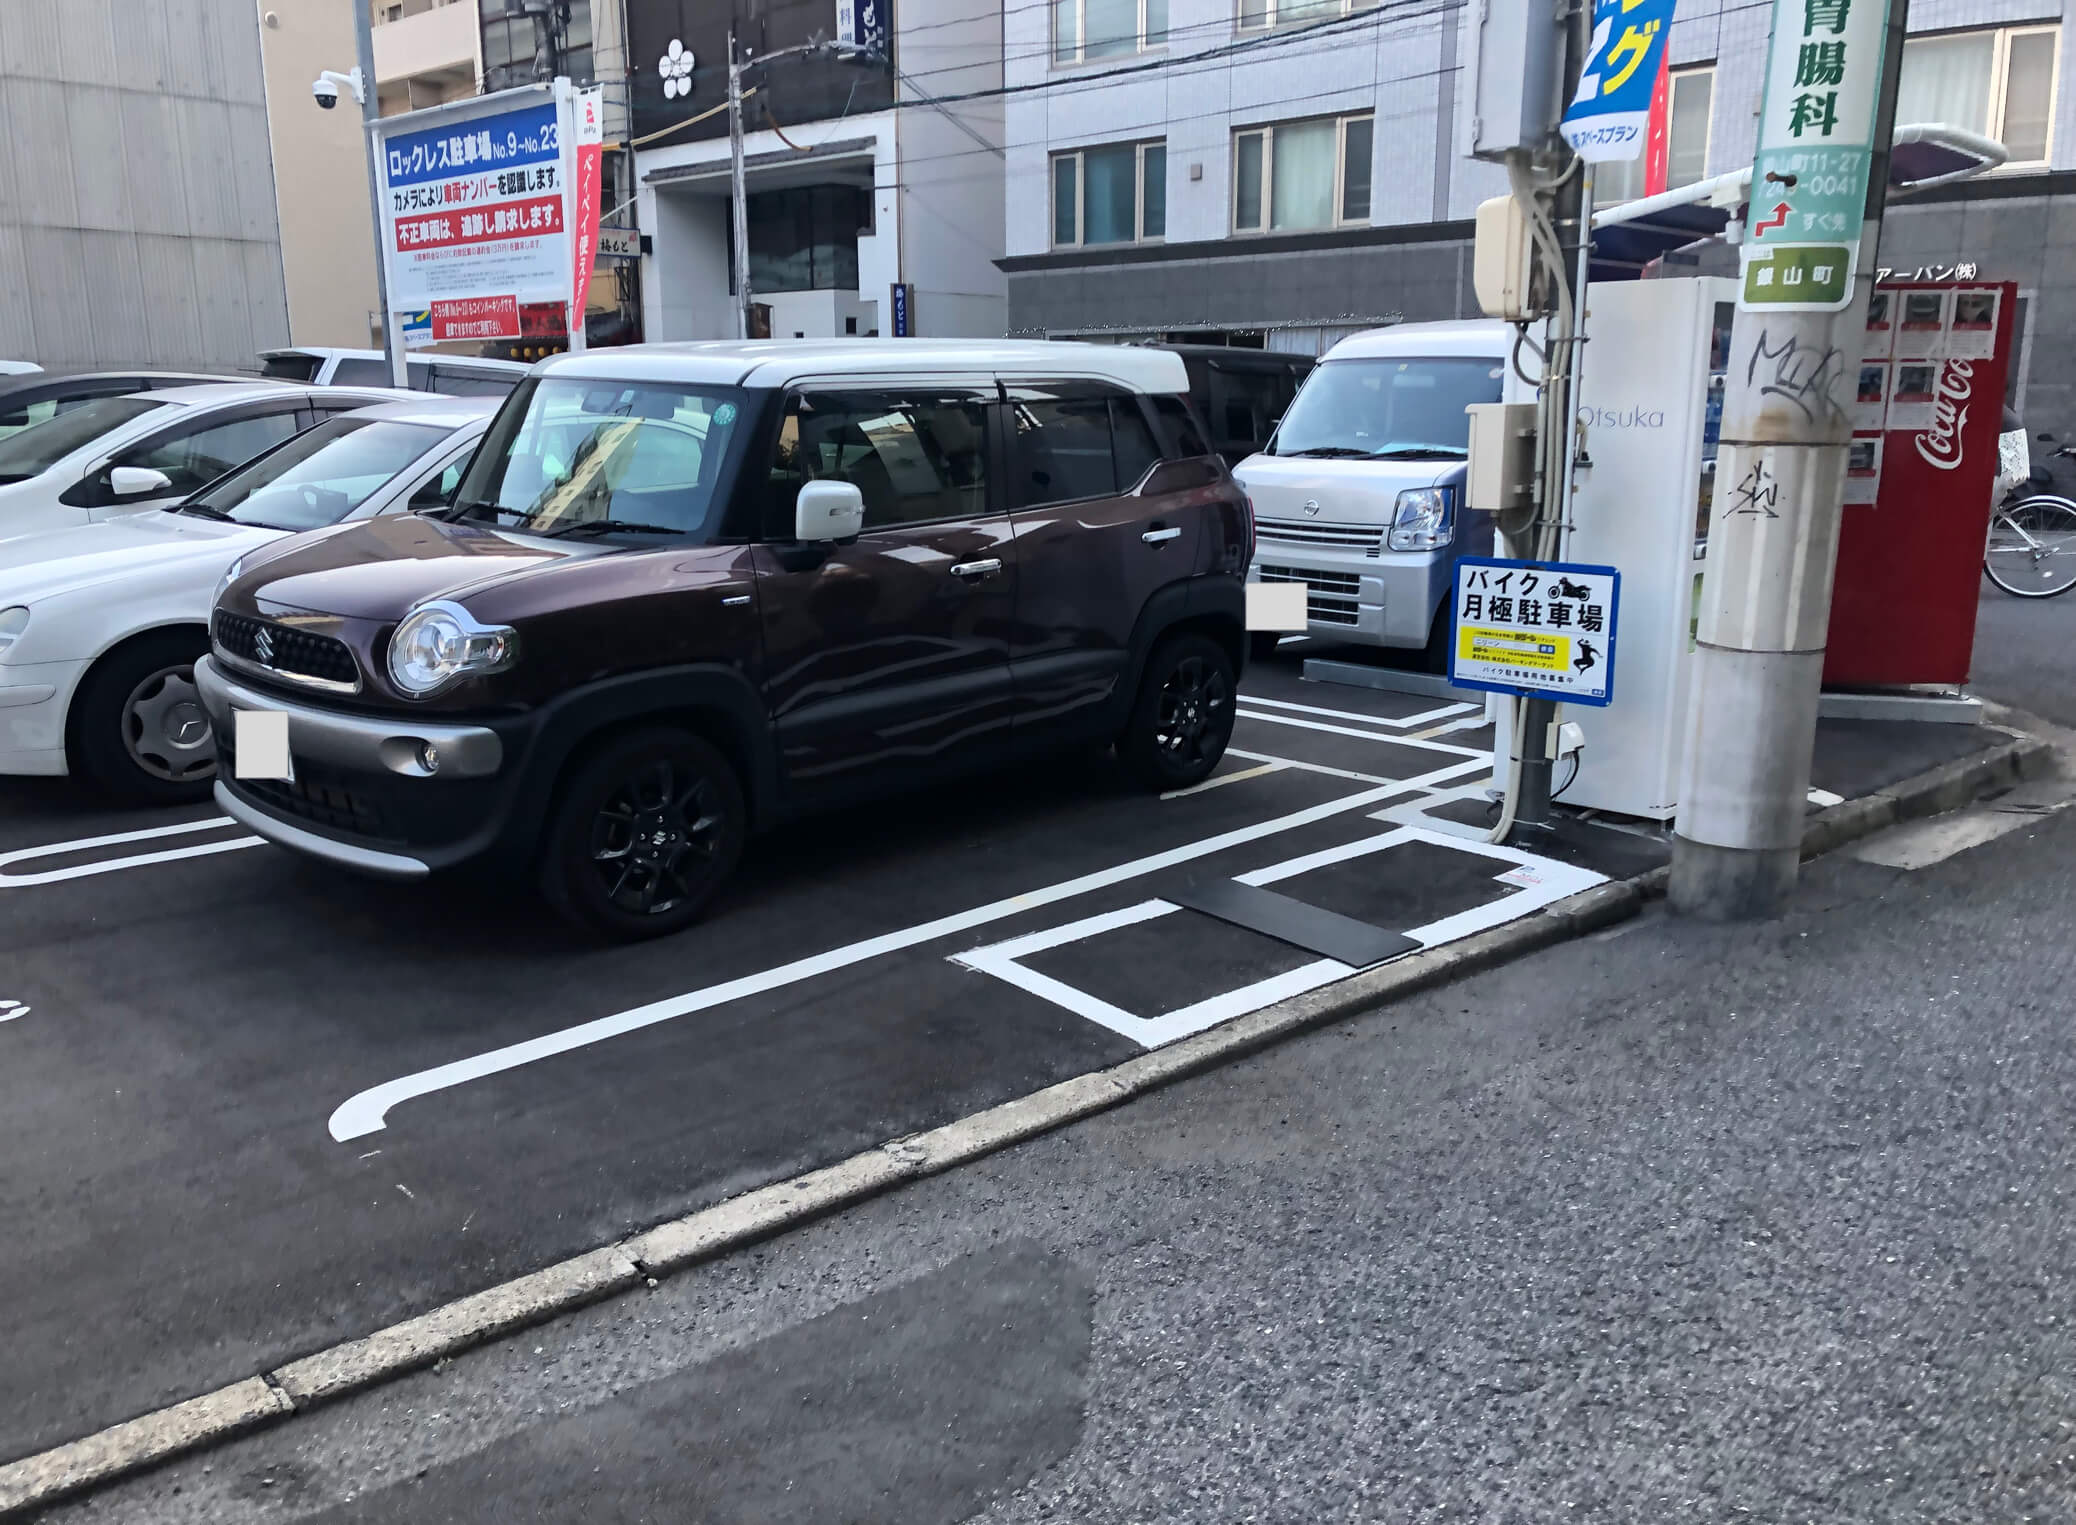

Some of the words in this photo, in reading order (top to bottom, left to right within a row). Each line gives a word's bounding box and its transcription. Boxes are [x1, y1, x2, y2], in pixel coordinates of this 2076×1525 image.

[1576, 405, 1665, 429] Otsuka
[1466, 570, 1540, 596] バイク
[1462, 594, 1604, 633] 月極駐車場
